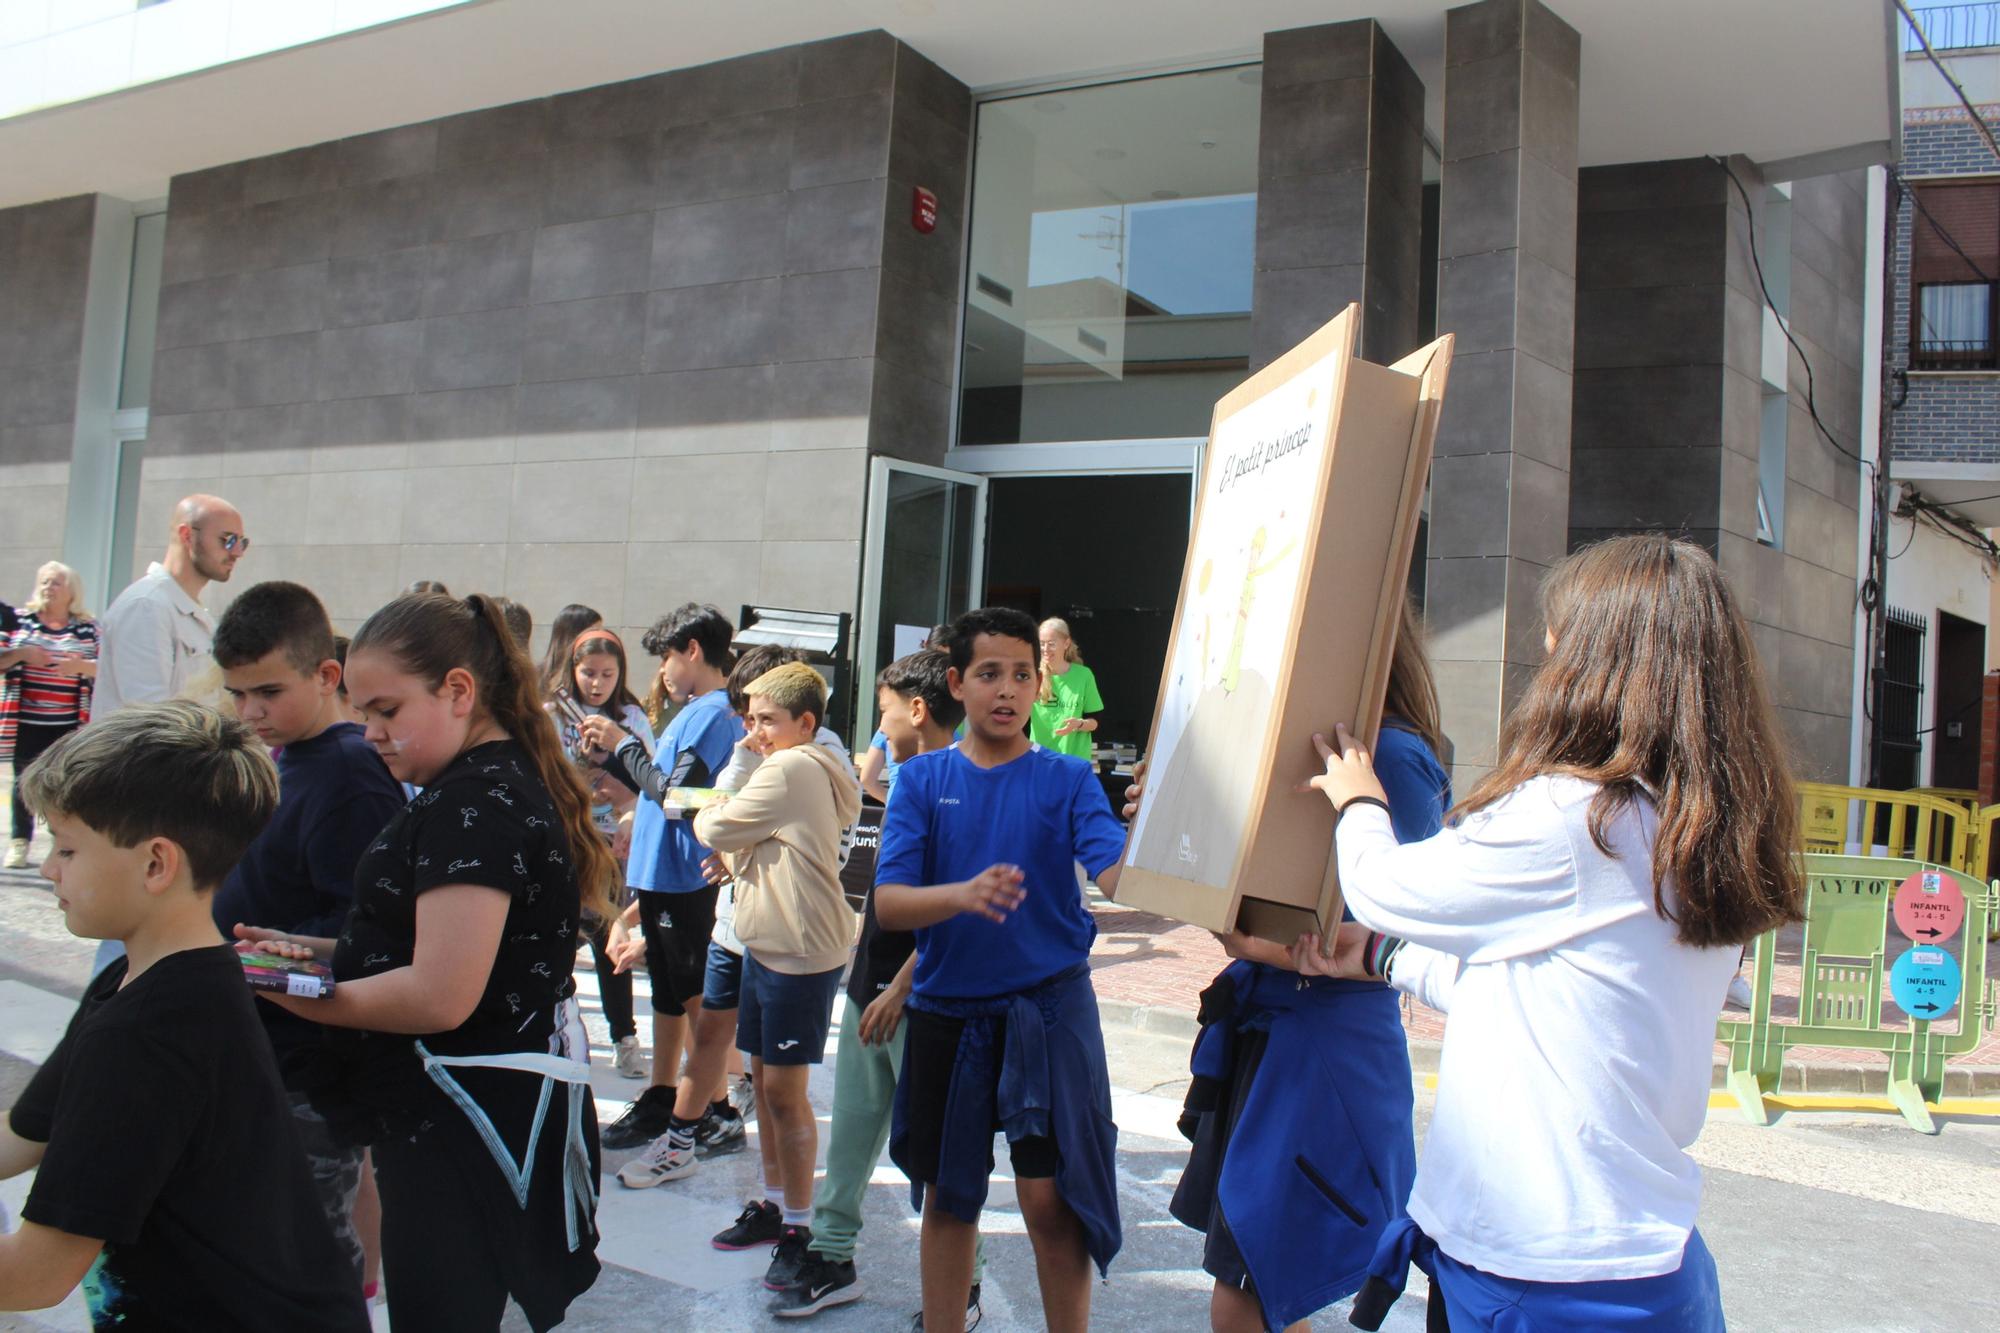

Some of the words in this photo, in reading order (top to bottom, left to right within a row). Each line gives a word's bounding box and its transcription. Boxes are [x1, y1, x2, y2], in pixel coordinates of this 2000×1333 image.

[1219, 453, 1236, 494] El
[1232, 440, 1264, 489] petit
[850, 836, 880, 849] junt
[447, 858, 483, 875] Smile
[1910, 902, 1951, 912] INFANTIL
[1906, 977, 1947, 986] INFANTIL
